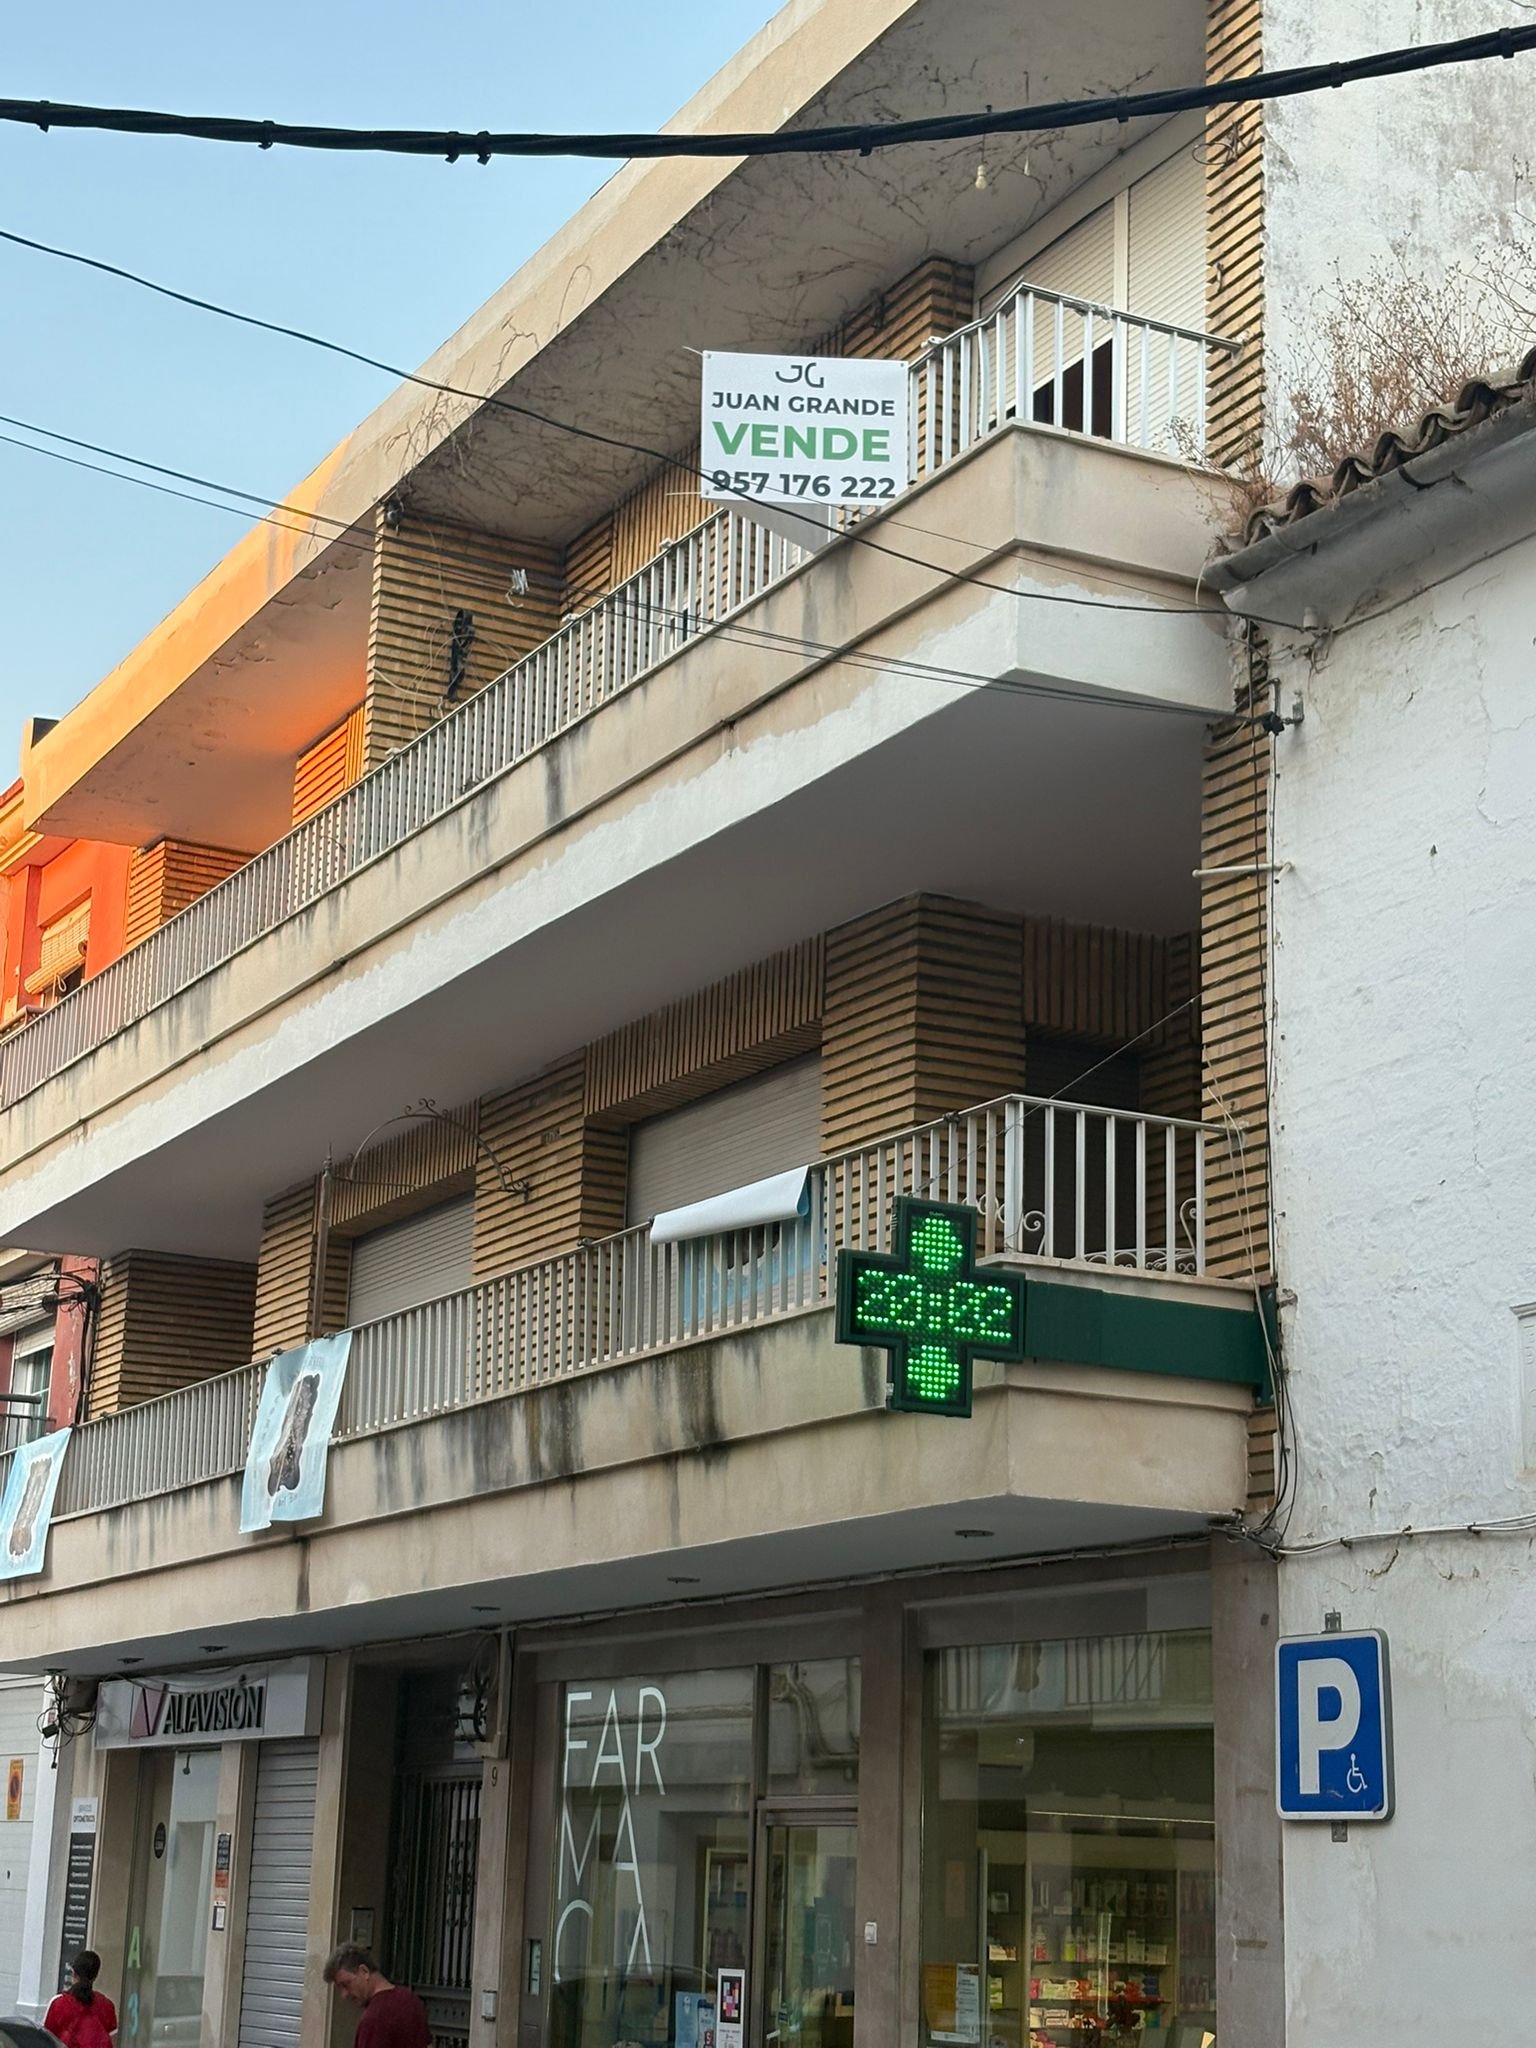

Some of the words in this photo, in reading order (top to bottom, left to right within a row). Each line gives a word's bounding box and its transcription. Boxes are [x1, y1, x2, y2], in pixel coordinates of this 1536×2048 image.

[712, 391, 780, 411] JUAN
[788, 396, 896, 416] GRANDE
[712, 421, 891, 462] VENDE
[712, 469, 770, 494] 957
[779, 473, 831, 497] 176
[840, 476, 896, 498] 222
[563, 1686, 667, 1796] FAR
[1297, 1657, 1361, 1794] P
[491, 1766, 498, 1787] 9
